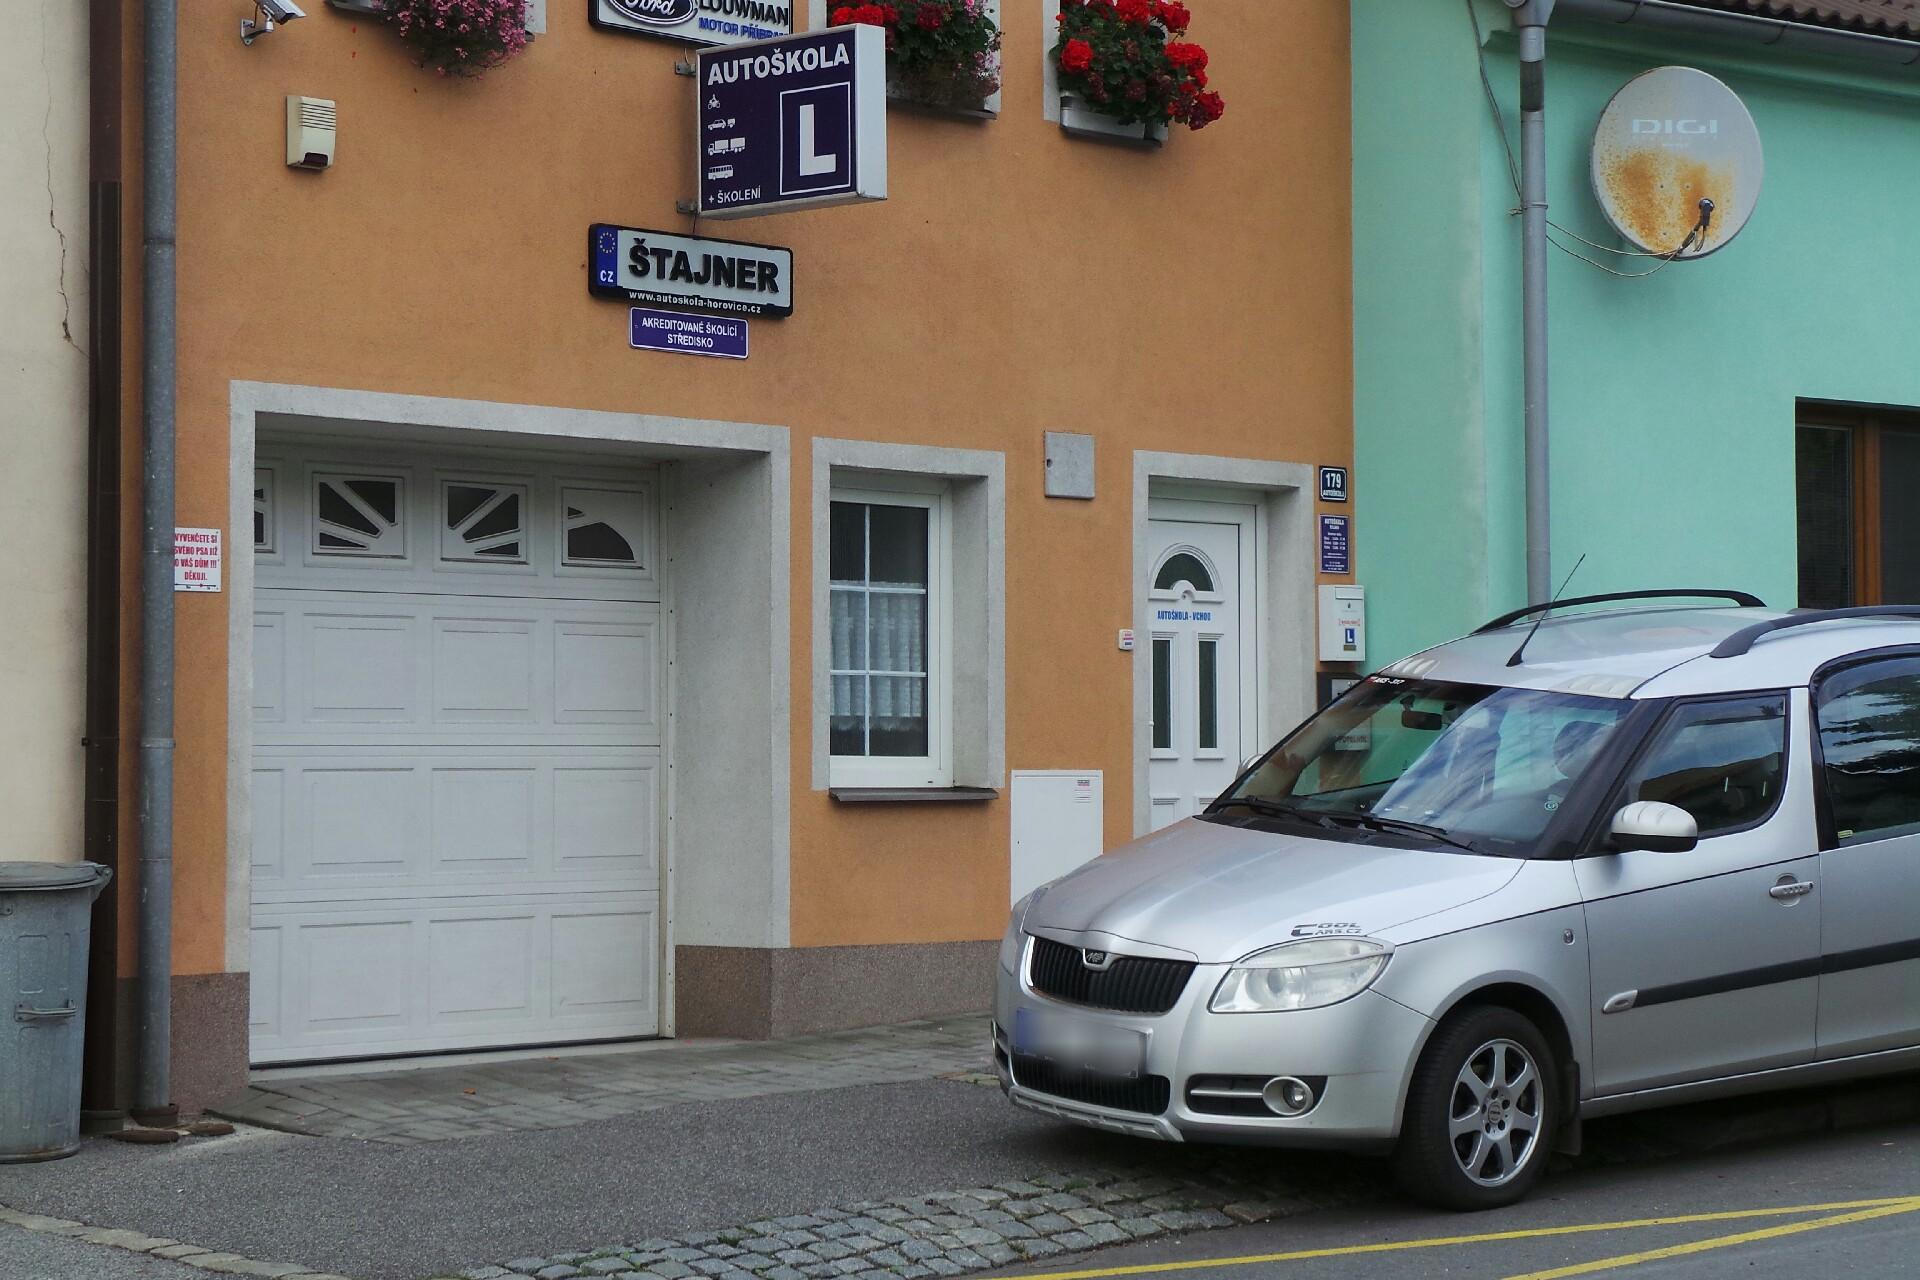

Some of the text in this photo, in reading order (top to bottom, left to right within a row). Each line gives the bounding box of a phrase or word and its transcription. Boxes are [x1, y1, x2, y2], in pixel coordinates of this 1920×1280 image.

[698, 17, 739, 36] MOTOR
[707, 42, 850, 86] AUTOŠKOLA
[1632, 119, 1718, 134] DIGI
[799, 103, 837, 177] L
[717, 185, 761, 204] ŠKOLENÍ
[628, 237, 780, 294] ŠTAJNER
[599, 269, 614, 283] CZ
[628, 291, 761, 314] www.autoskola-horovice.cz
[641, 317, 738, 337] AKREDITOVANÉ ŠKOLÍCÍ
[667, 333, 714, 348] STŘEDISKO
[1325, 472, 1342, 489] 179
[196, 546, 209, 555] PSA
[1157, 609, 1189, 620] AUTOŠKOLA
[1346, 629, 1353, 642] L
